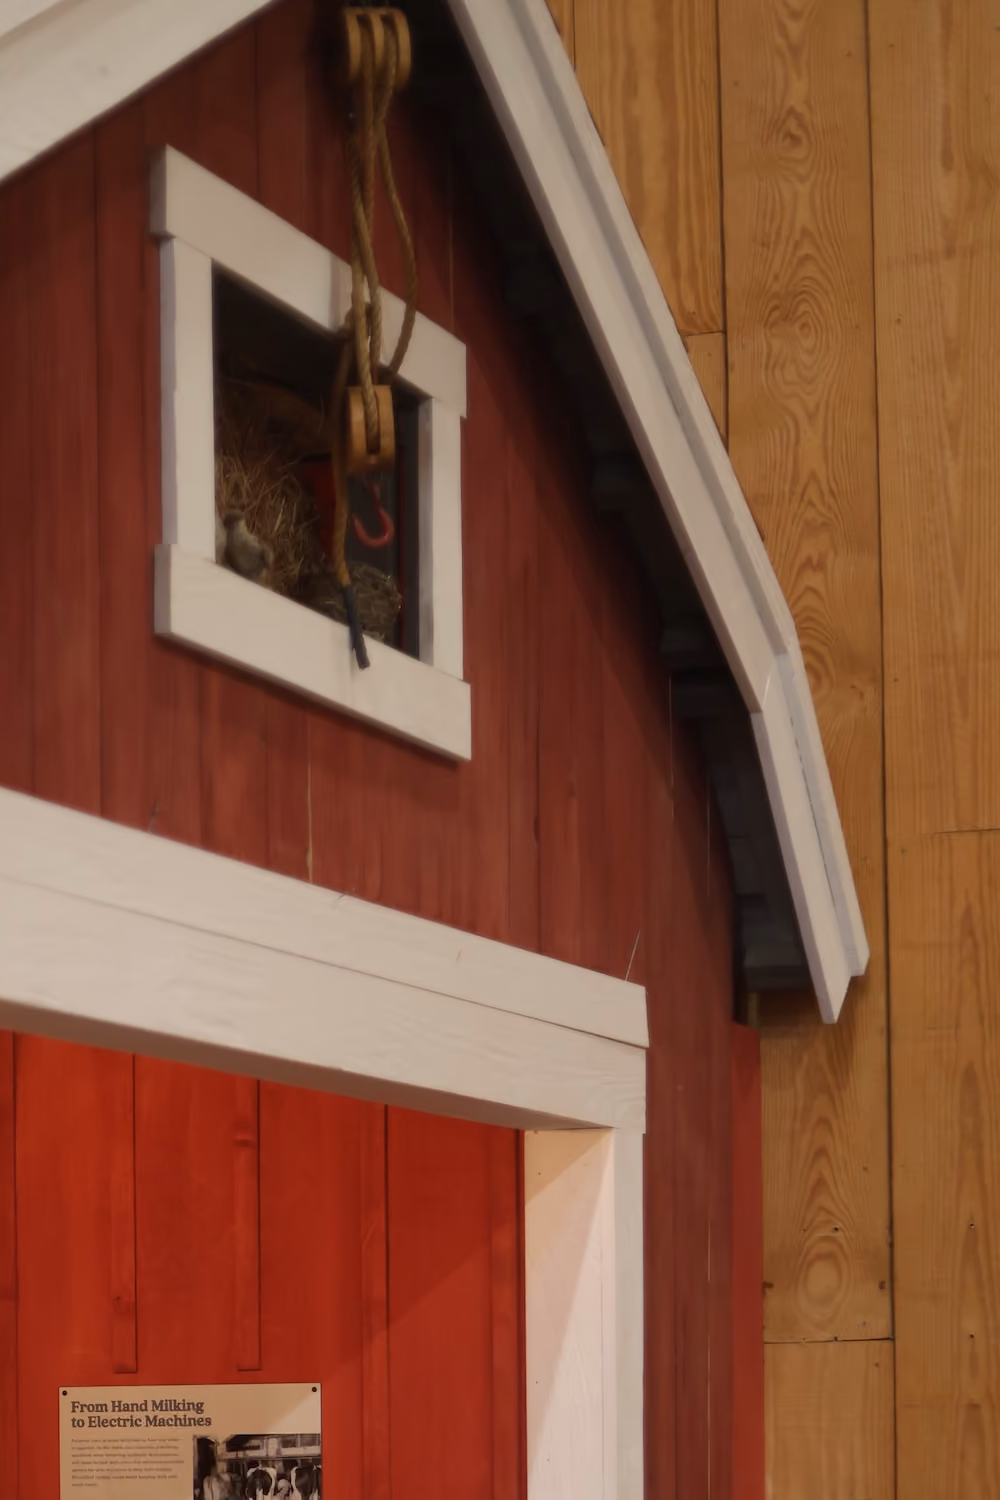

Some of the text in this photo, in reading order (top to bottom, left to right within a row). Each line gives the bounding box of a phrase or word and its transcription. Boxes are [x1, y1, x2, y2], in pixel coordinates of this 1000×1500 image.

[71, 1399, 204, 1414] From Hand Milking
[71, 1414, 212, 1428] to Electric Machines
